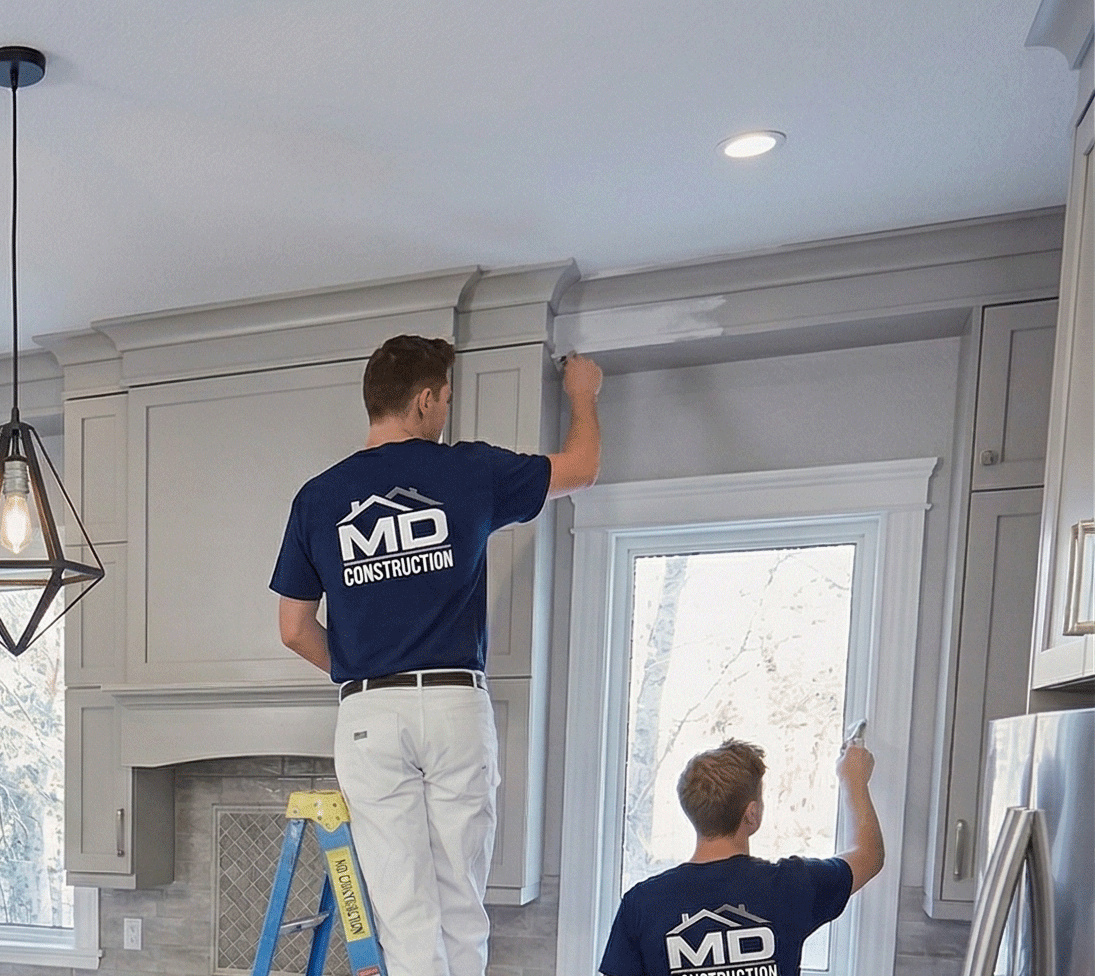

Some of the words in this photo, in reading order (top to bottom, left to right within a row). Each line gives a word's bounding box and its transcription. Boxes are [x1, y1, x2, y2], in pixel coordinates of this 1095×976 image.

[338, 508, 449, 561] MD
[343, 549, 454, 587] CONSTRUCTION
[666, 926, 775, 970] MD
